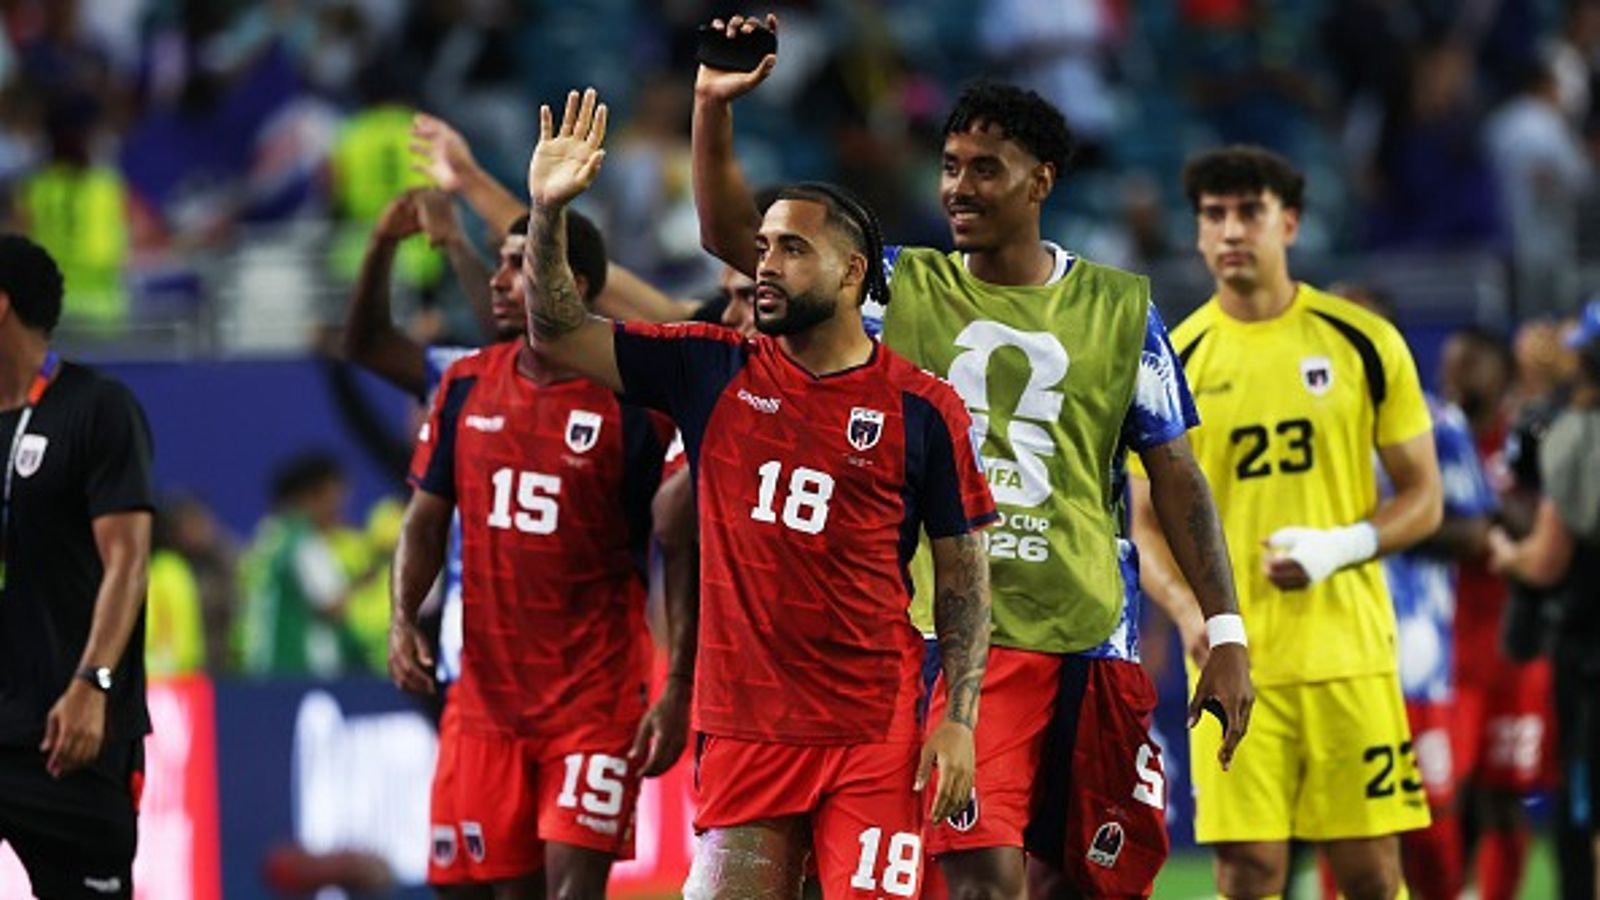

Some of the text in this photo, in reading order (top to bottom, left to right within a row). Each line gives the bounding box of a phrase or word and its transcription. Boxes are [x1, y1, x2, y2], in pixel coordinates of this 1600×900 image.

[984, 466, 1023, 489] IFA
[1231, 419, 1314, 480] 23
[487, 469, 562, 535] 15
[751, 461, 834, 534] 18
[1009, 514, 1050, 532] CUP
[982, 530, 1049, 562] 26
[557, 753, 628, 816] 15
[850, 827, 921, 897] 18
